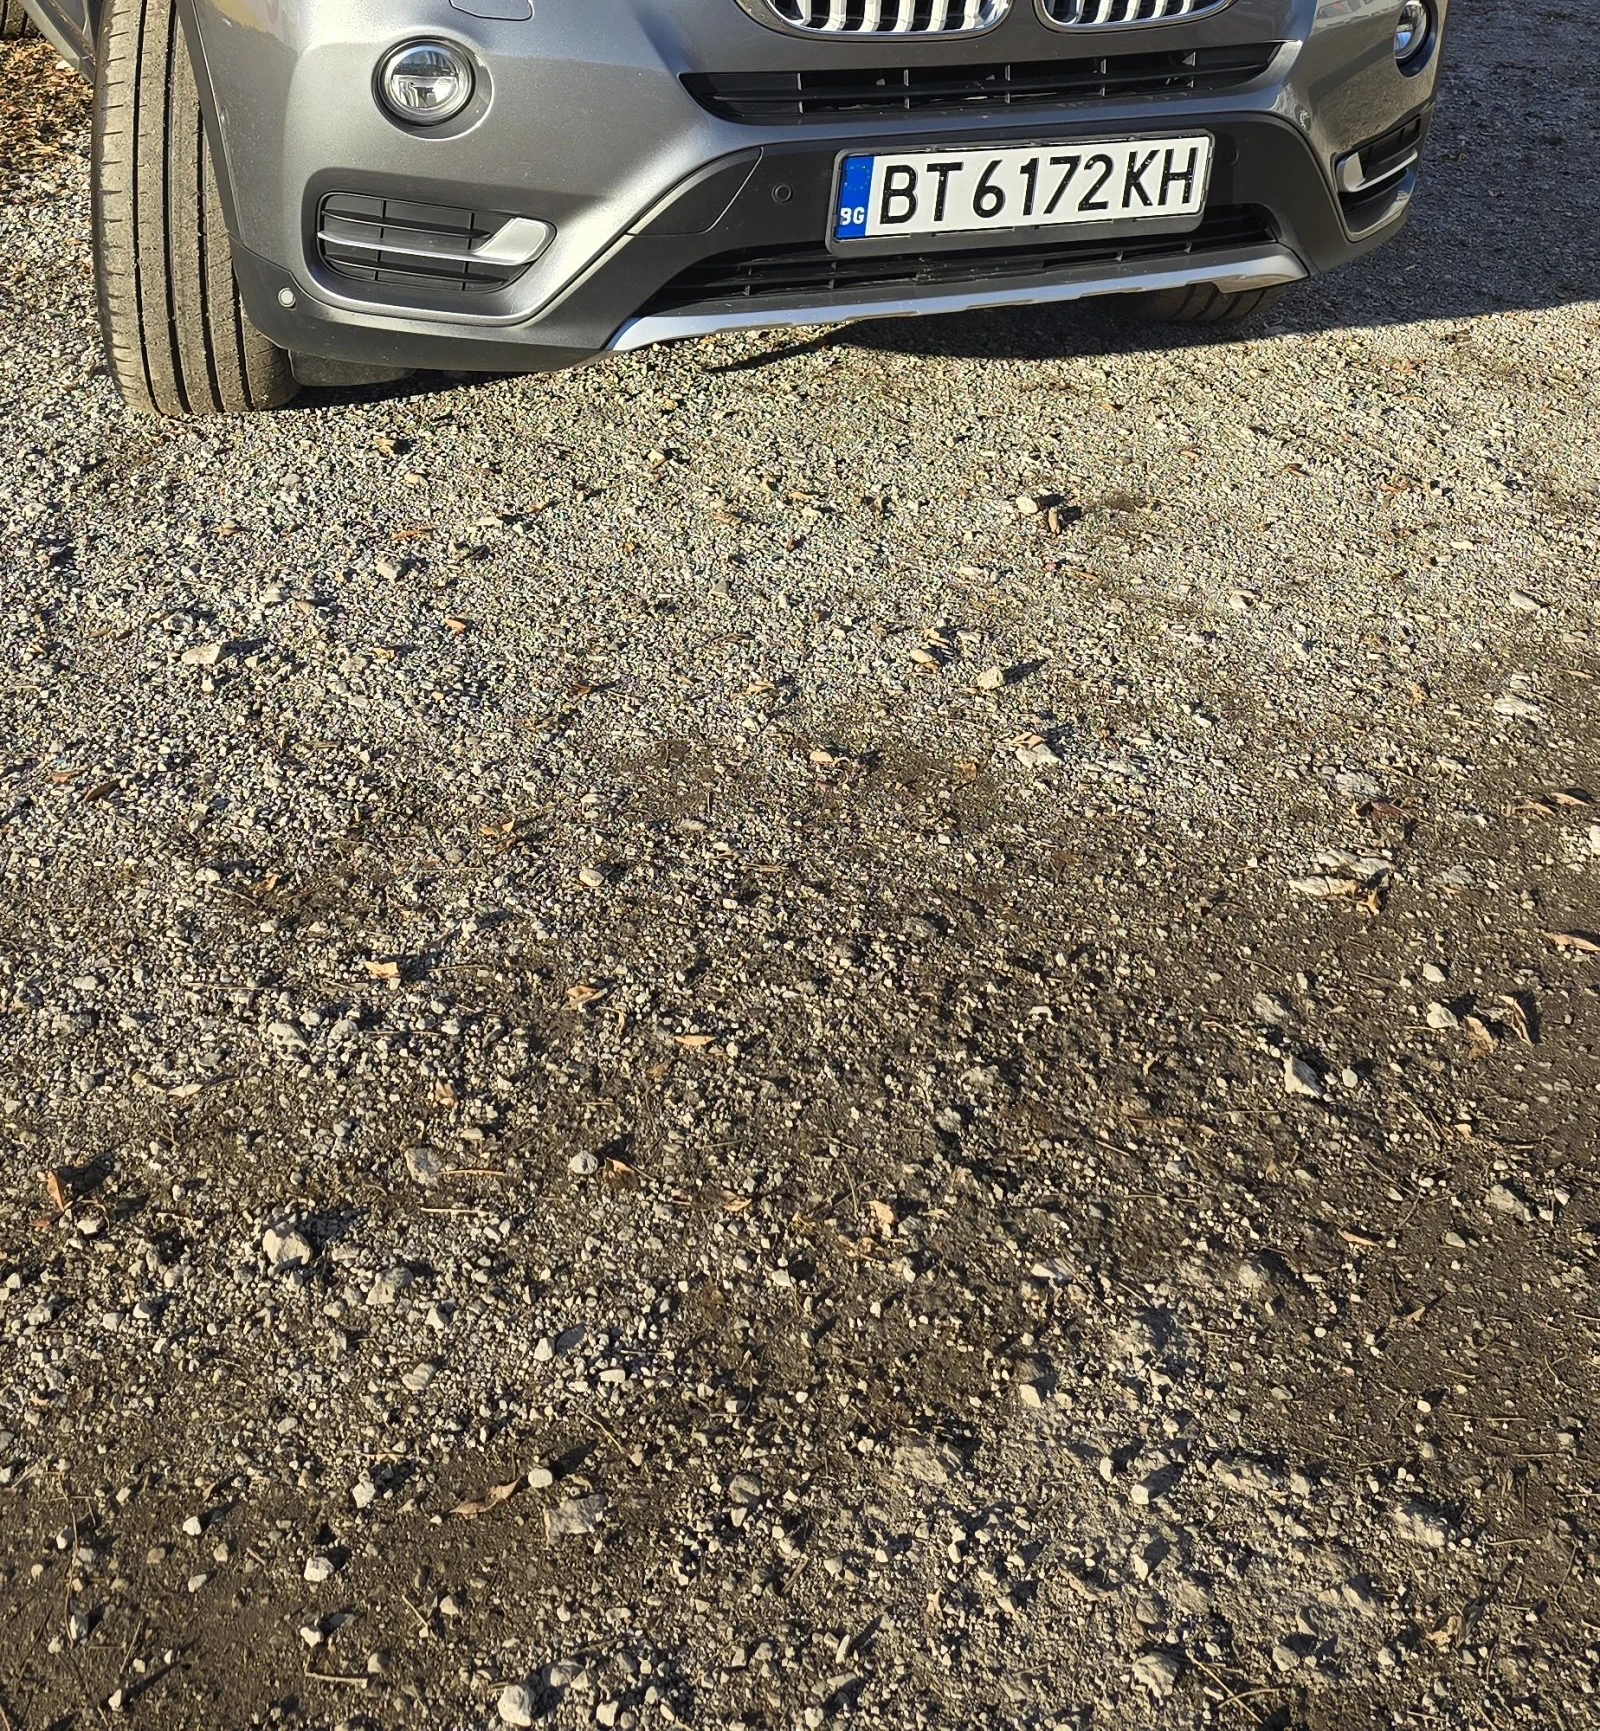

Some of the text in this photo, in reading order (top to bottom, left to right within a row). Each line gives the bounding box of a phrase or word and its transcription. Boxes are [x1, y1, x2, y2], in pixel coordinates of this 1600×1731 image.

[879, 146, 1199, 225] BT 6172 KH
[840, 206, 865, 226] BG
